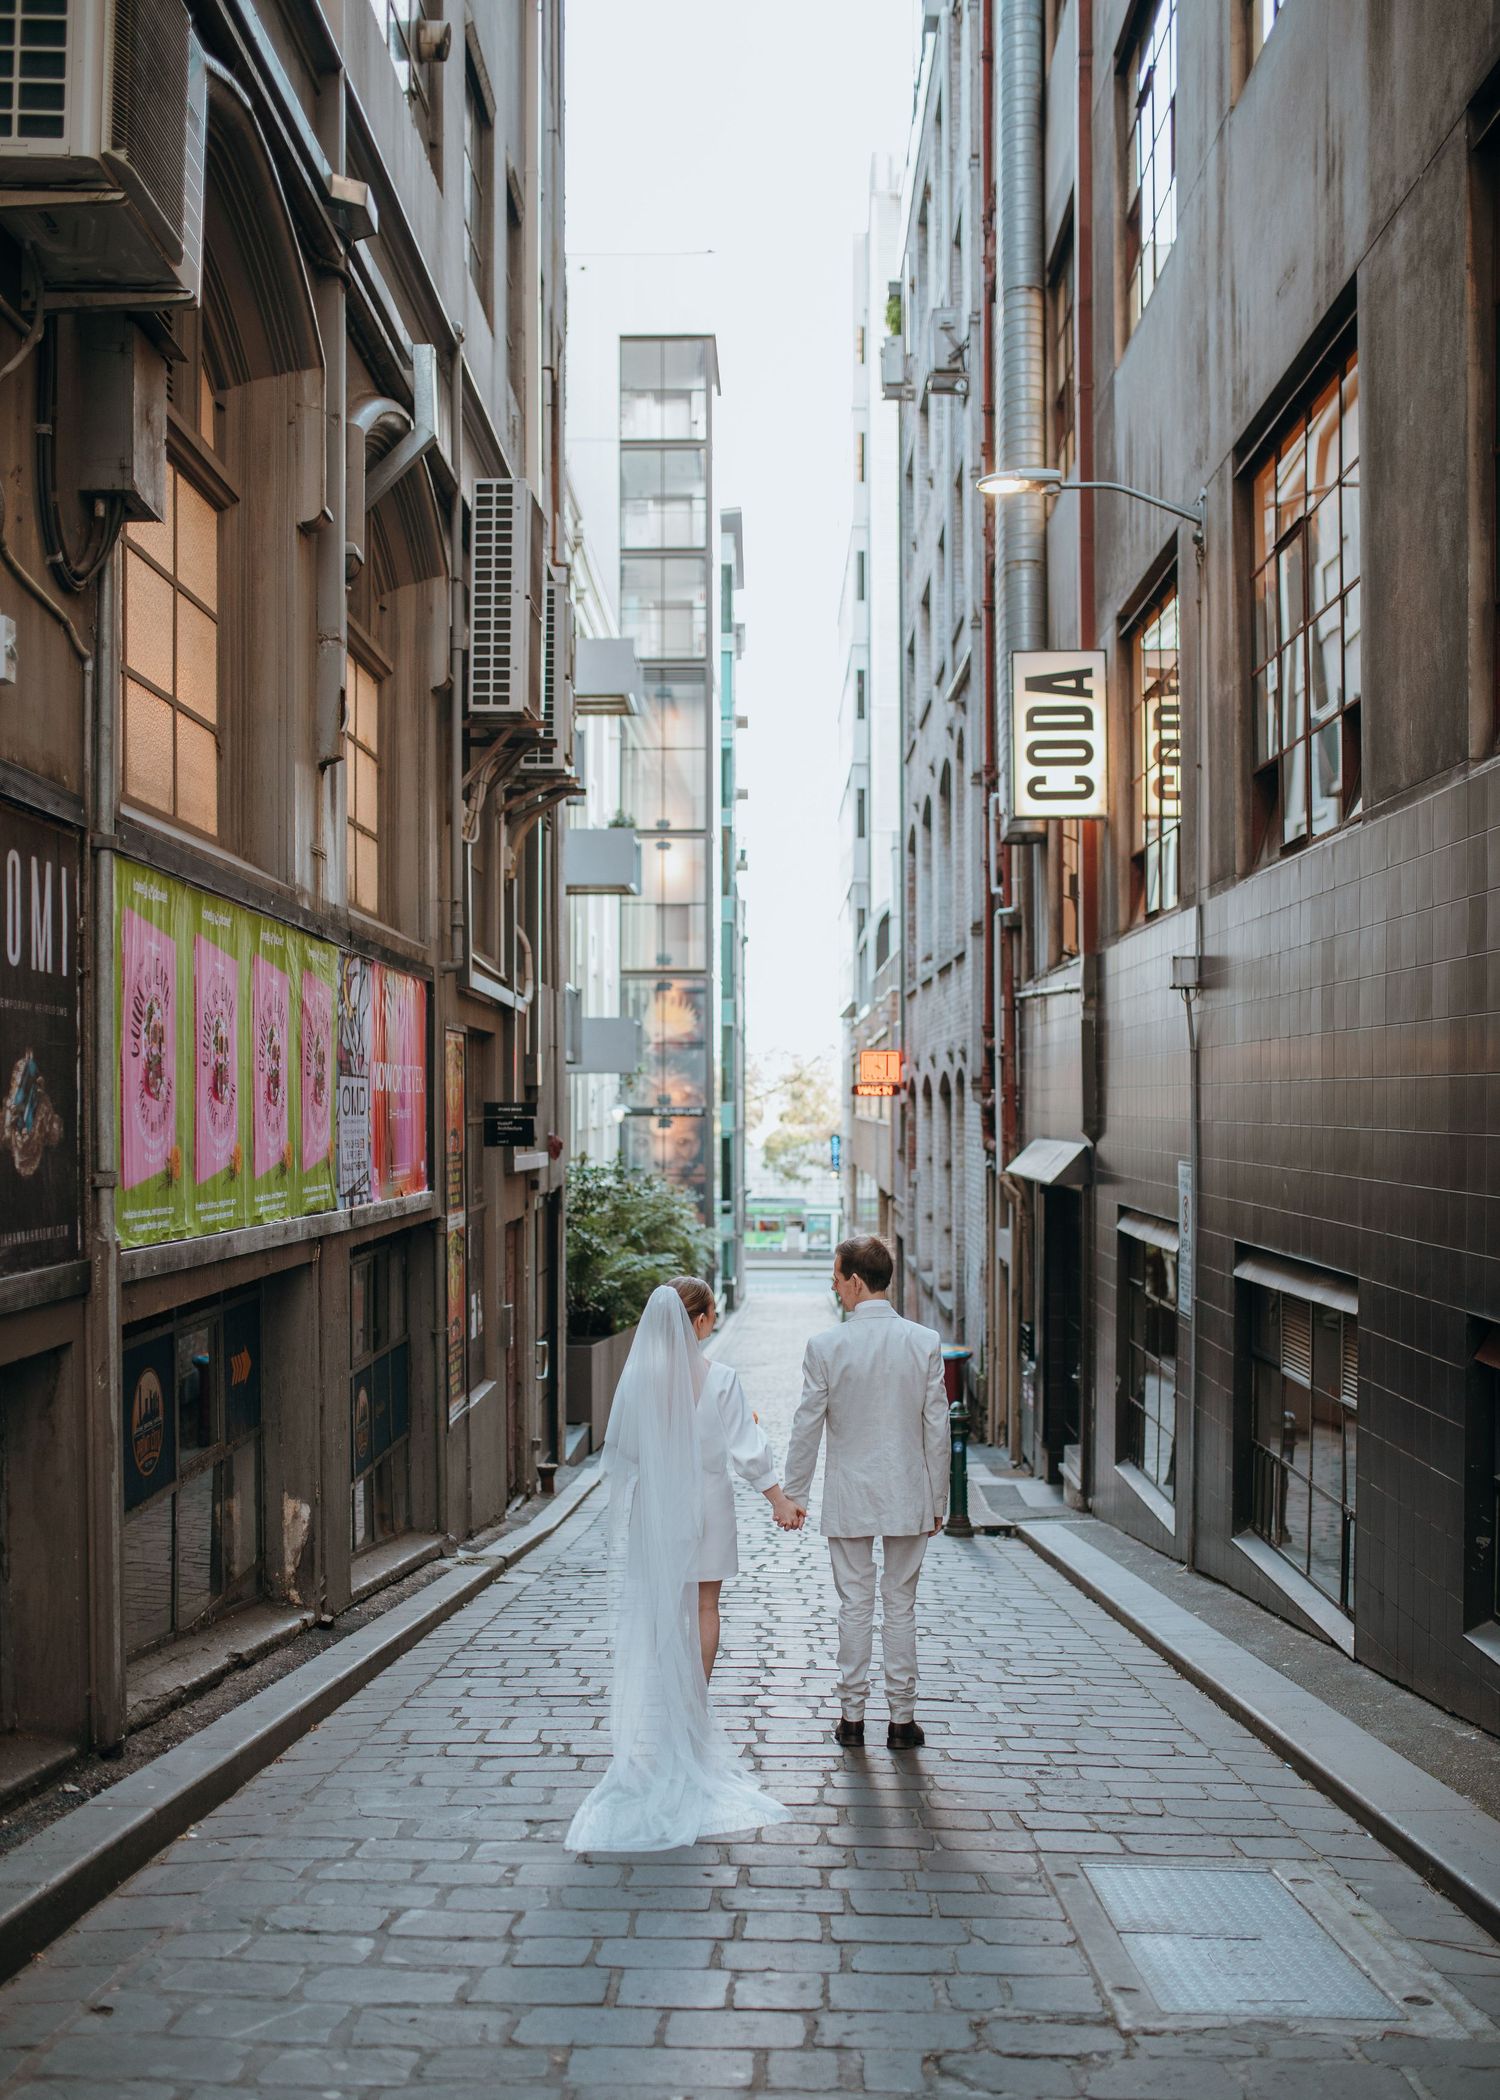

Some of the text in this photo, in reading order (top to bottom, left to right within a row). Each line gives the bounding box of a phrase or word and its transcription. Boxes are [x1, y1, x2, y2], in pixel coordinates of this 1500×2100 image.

[1025, 667, 1095, 801] CODA
[6, 848, 68, 977] OMI
[342, 1085, 365, 1117] OMD
